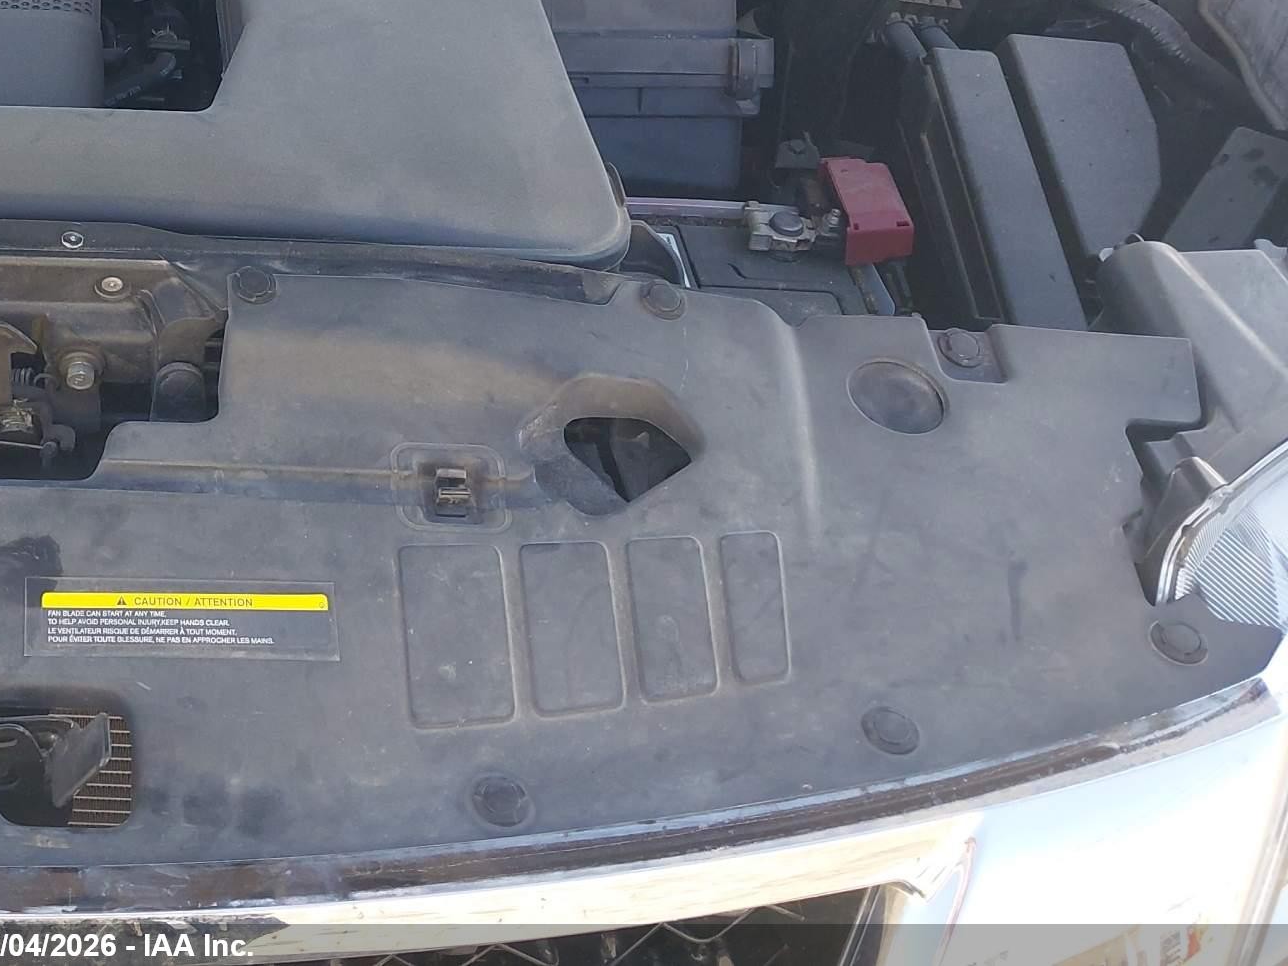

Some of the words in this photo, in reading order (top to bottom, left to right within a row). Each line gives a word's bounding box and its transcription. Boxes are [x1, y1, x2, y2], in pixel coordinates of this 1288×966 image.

[134, 597, 182, 606] CAUTION
[194, 597, 253, 607] ATTENTION
[140, 626, 179, 635] DÉMARRER
[47, 635, 68, 643] POUR
[181, 636, 191, 644] EN
